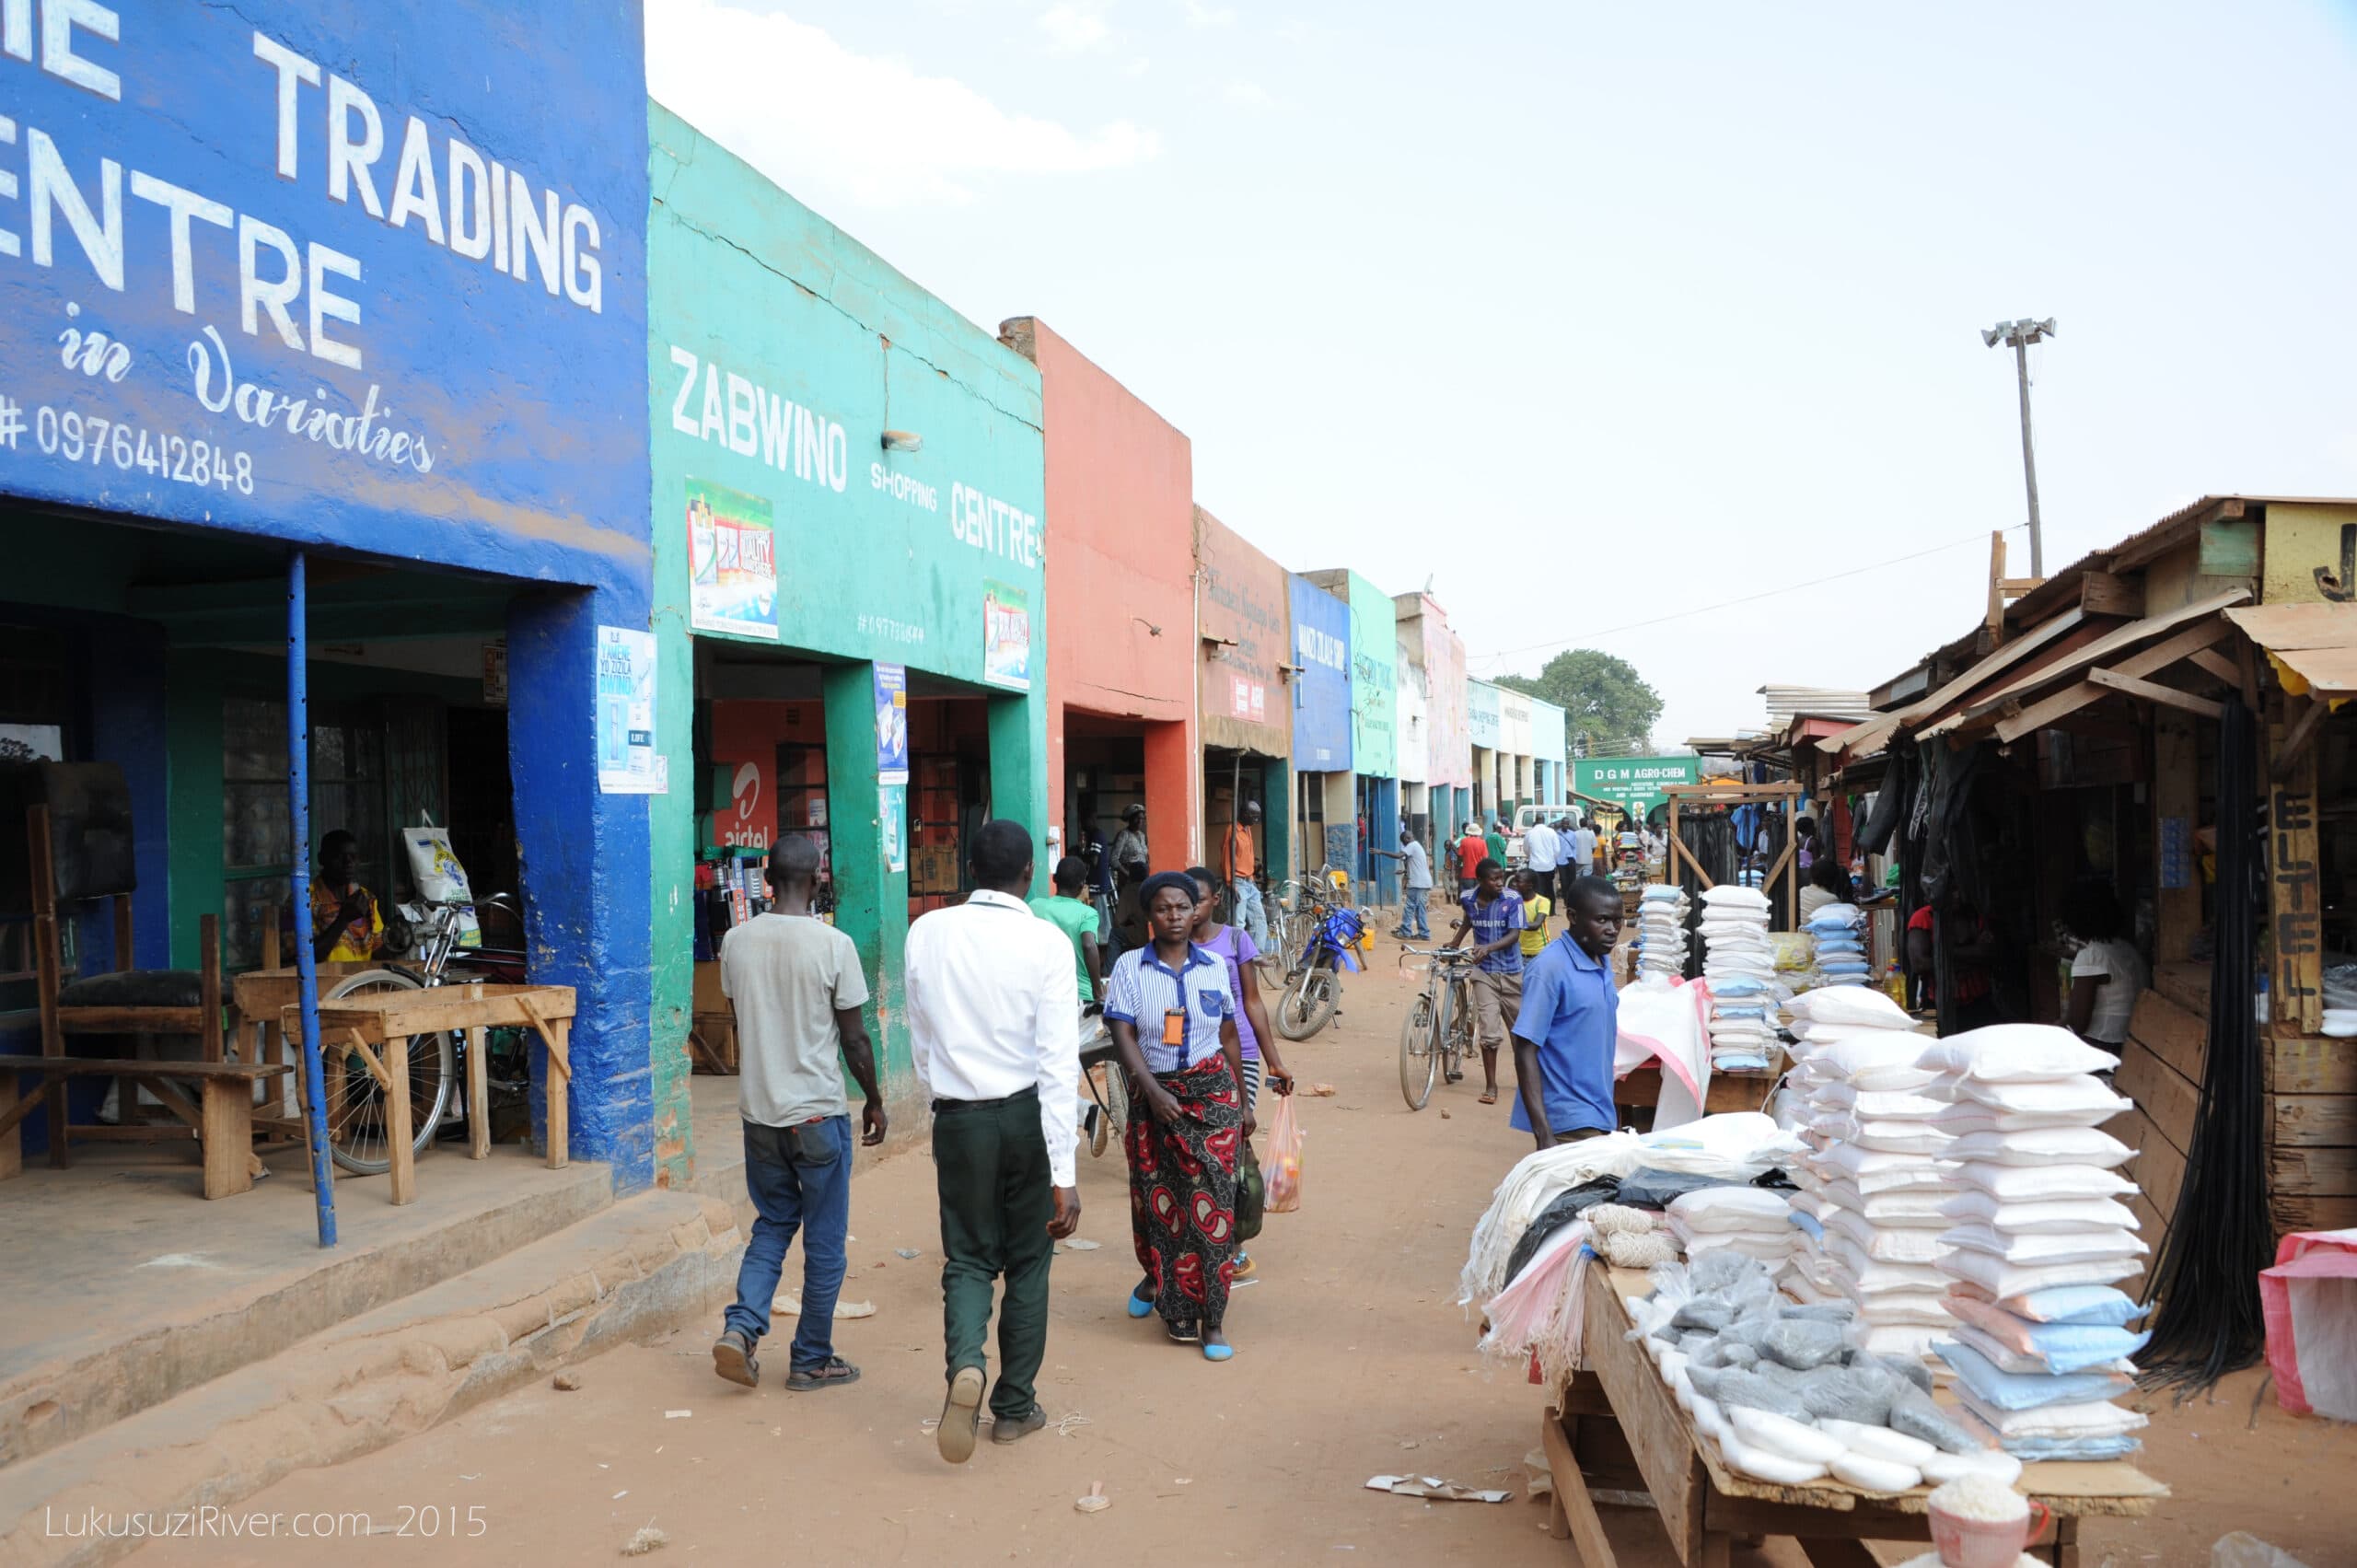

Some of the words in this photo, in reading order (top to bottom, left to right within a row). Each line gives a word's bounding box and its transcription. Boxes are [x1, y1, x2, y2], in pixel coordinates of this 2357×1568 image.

[253, 31, 602, 314] TRADING
[58, 301, 133, 383] in
[37, 405, 254, 494] 0976412848
[670, 345, 847, 493] ZABWINO
[870, 463, 937, 513] SHOPPING
[951, 482, 1036, 569] CENTRE
[1595, 769, 1604, 780] D
[1607, 769, 1617, 780] G
[1620, 769, 1630, 779] M
[1634, 767, 1686, 779] AGRO-CHEM
[725, 824, 768, 851] airtel
[2275, 791, 2316, 996] ELTEL
